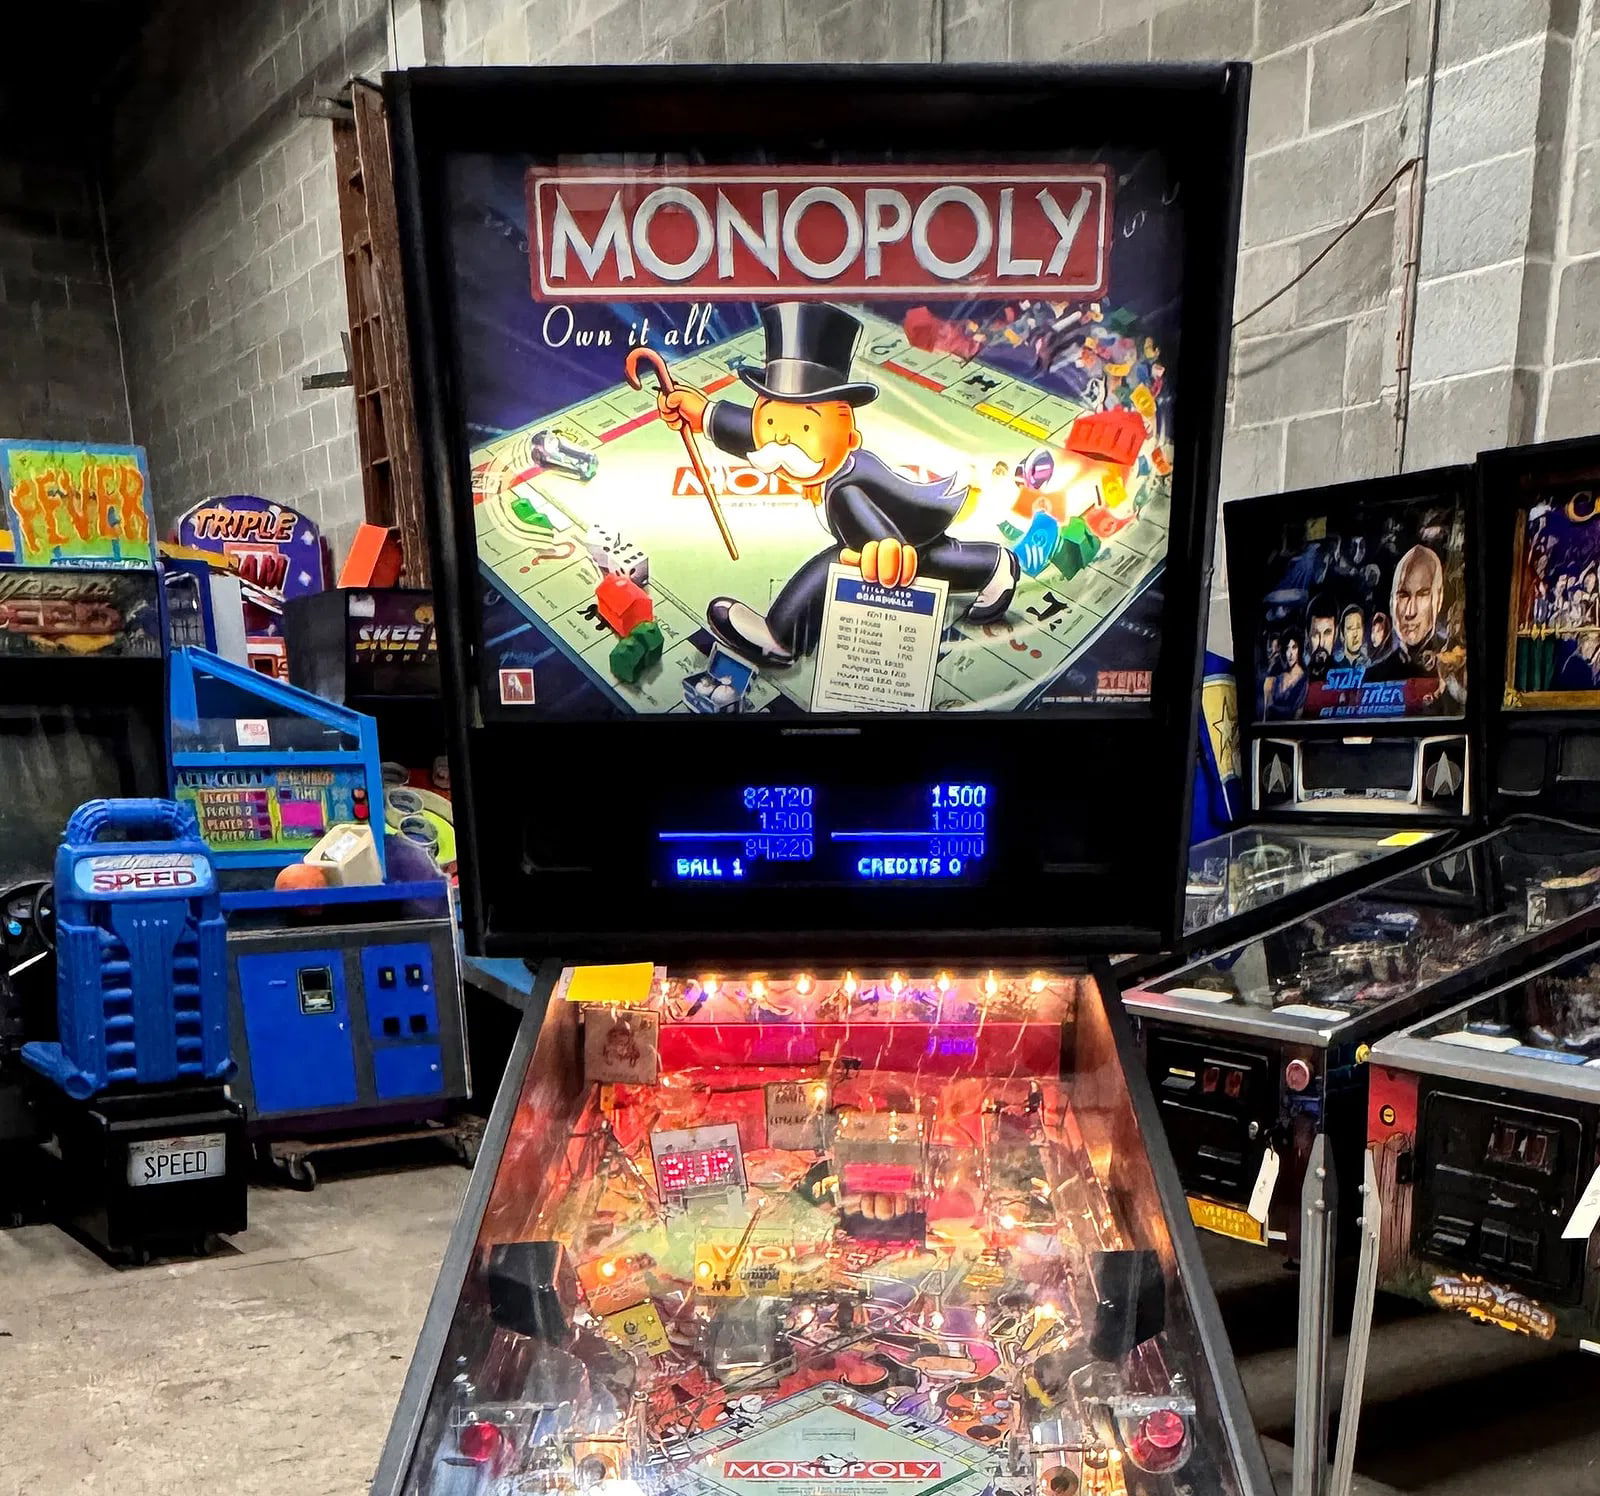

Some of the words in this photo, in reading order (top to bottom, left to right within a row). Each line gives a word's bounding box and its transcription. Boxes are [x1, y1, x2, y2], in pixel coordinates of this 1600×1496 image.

[550, 186, 1091, 282] MONOPOLY
[543, 305, 612, 347] Own
[629, 318, 649, 346] it
[193, 507, 298, 542] TRIPLE
[677, 858, 723, 876] BALL
[732, 858, 744, 876] 1
[858, 858, 941, 876] CREDITS
[93, 871, 197, 891] SPEED
[144, 1151, 207, 1179] SPEED
[727, 1461, 939, 1479] MONOPOLY
